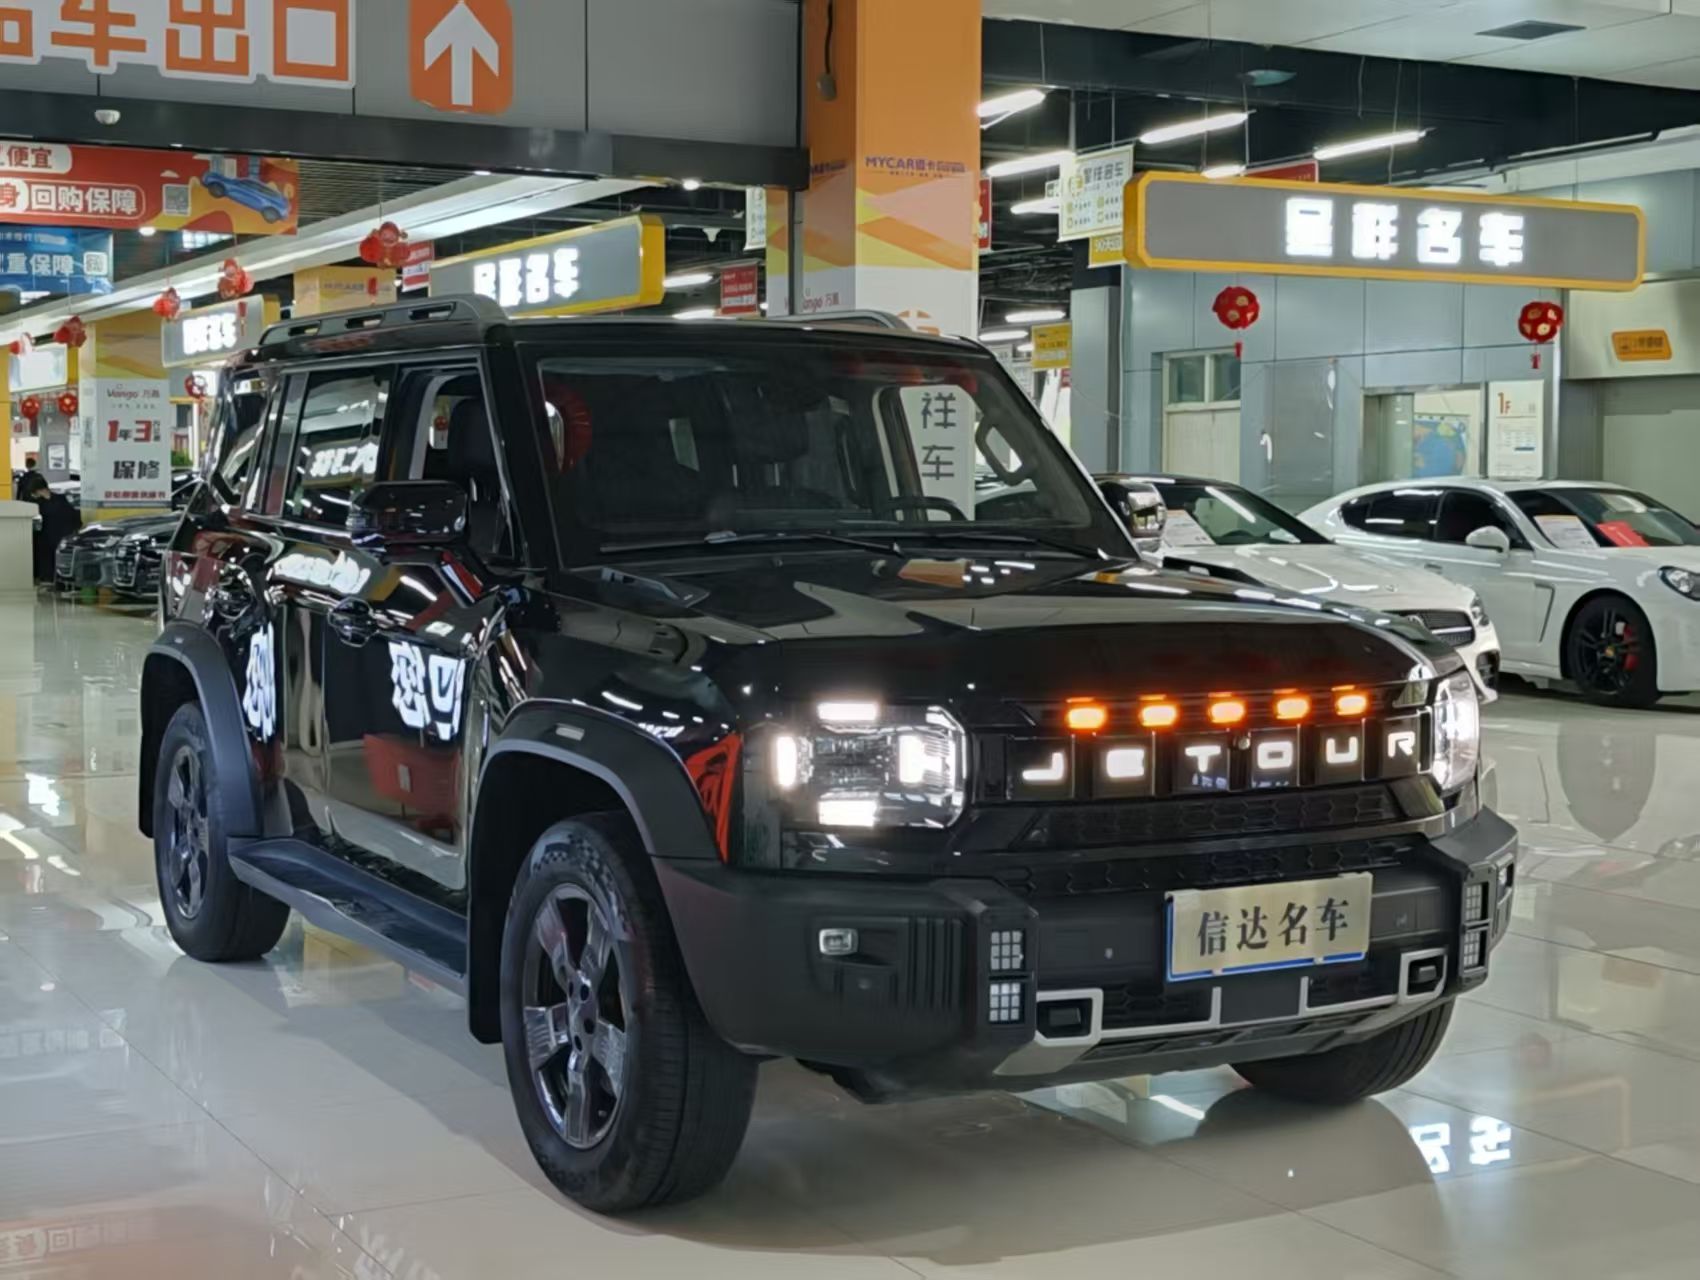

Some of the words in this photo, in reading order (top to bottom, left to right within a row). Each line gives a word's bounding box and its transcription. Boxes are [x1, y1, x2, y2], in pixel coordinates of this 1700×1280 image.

[0, 144, 53, 169] 便宜
[31, 184, 137, 214] 回购保障
[0, 252, 74, 276] 重保障
[113, 460, 160, 480] 保修
[1197, 897, 1349, 956] 信达名车
